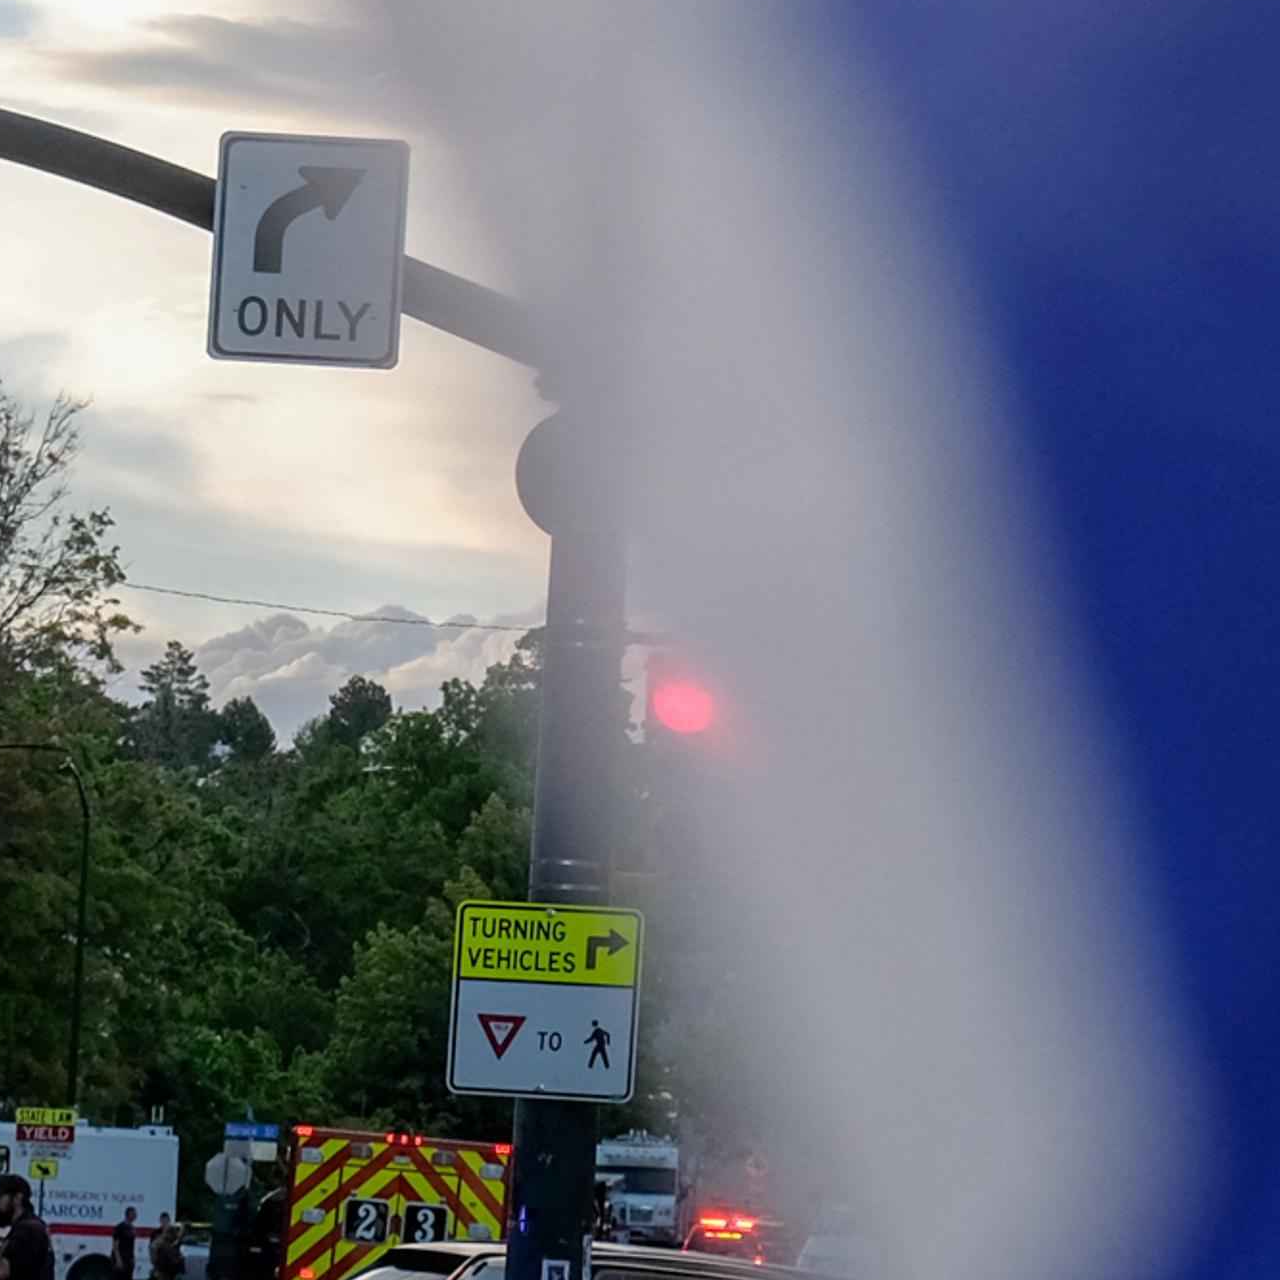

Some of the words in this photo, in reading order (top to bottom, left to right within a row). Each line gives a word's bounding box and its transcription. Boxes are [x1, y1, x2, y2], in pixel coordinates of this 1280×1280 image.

[237, 296, 373, 342] ONLY
[469, 917, 567, 942] TURNING
[468, 948, 576, 973] VEHICLES
[537, 1032, 562, 1051] TO
[20, 1110, 46, 1123] STATE
[22, 1125, 70, 1140] YIELD
[49, 1189, 109, 1201] EMERGENCY
[355, 1204, 379, 1241] 2
[414, 1208, 436, 1242] 3
